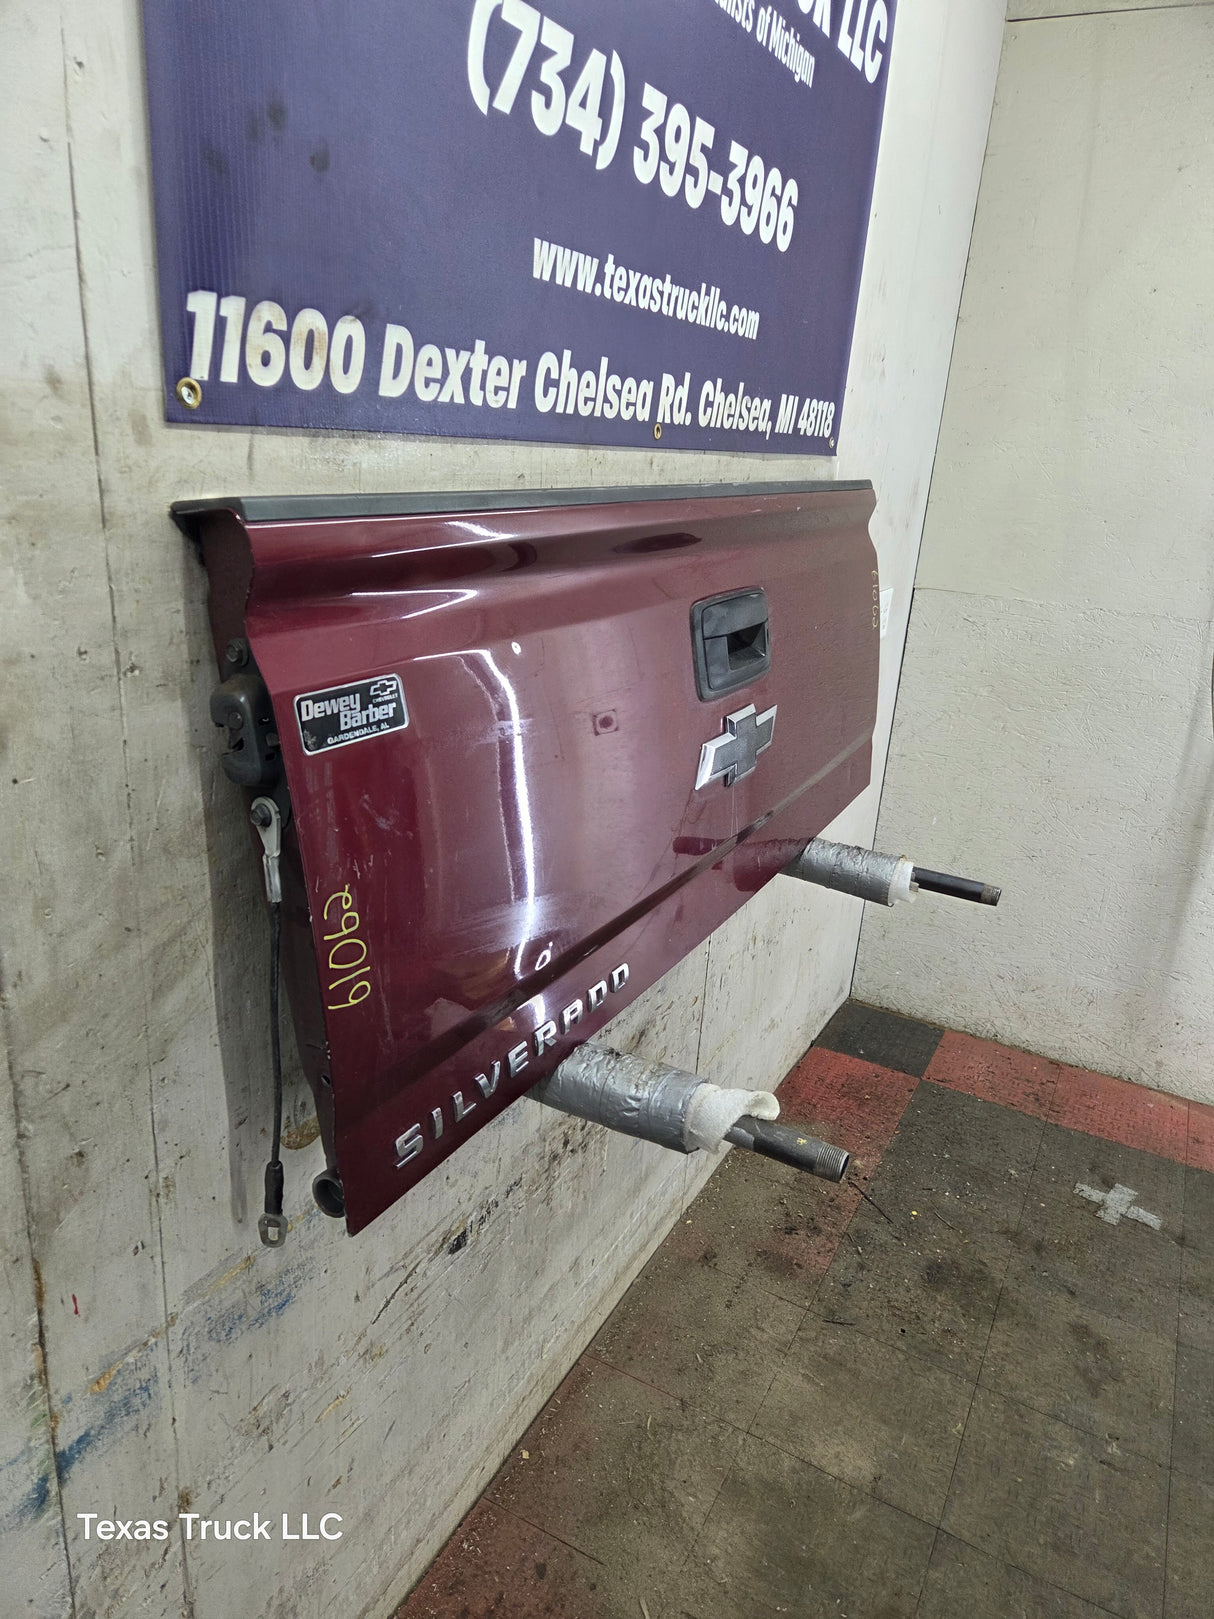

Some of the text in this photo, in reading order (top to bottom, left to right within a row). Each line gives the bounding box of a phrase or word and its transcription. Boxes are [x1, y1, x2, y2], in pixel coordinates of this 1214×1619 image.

[756, 6, 772, 46] of
[769, 10, 815, 88] Michigan
[838, 0, 888, 84] LLC
[467, 0, 799, 252] (734) 395-3966
[533, 238, 760, 339] www.texastruckllc.com
[186, 289, 836, 440] 11600 Dexter Chelsea Rd. Chelsea, MI 48118
[301, 693, 360, 721] Dewey
[327, 725, 380, 744] GARDENDALE,
[340, 702, 397, 731] Barber
[394, 962, 630, 1169] SILVERADO
